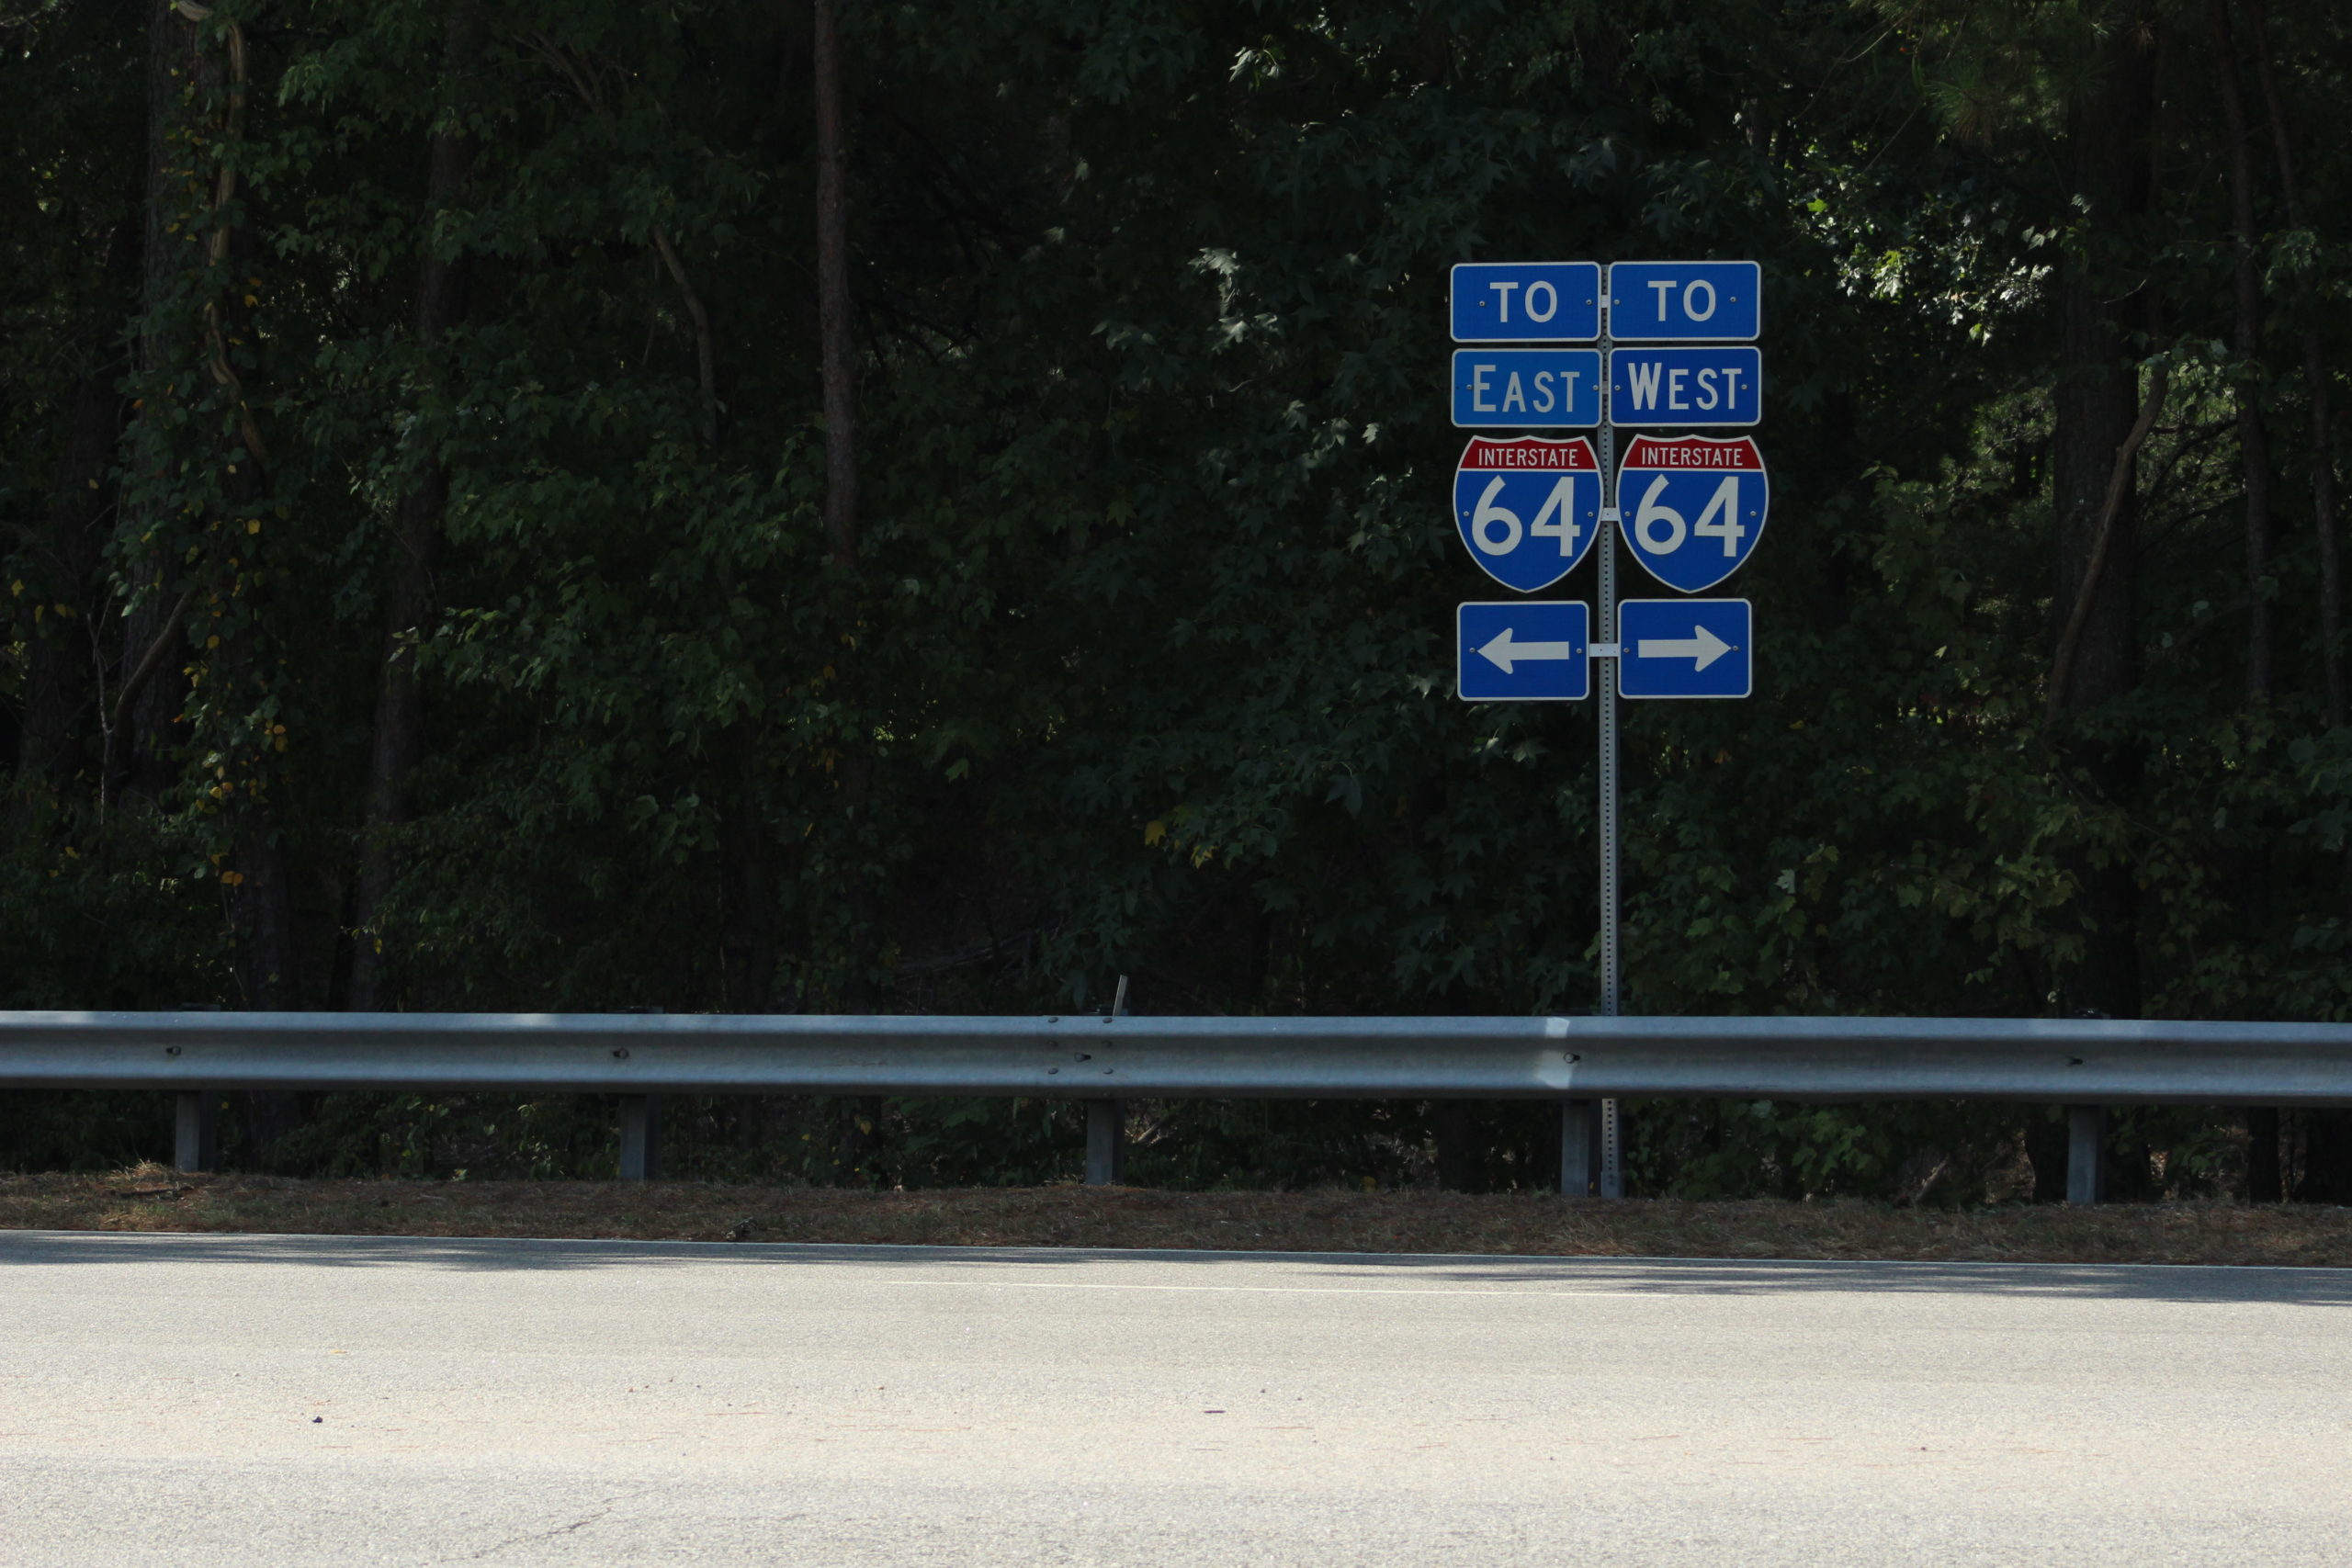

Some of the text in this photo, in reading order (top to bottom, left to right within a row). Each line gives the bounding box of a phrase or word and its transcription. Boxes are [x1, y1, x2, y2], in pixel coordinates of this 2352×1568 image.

[1489, 280, 1557, 323] TO
[1647, 279, 1717, 322] TO
[1472, 364, 1580, 413] EAST
[1627, 362, 1742, 411] WEST
[1477, 447, 1578, 467] INTERSTATE
[1641, 446, 1744, 467] INTERSTATE
[1471, 474, 1581, 557] 64
[1634, 473, 1746, 558] 64
